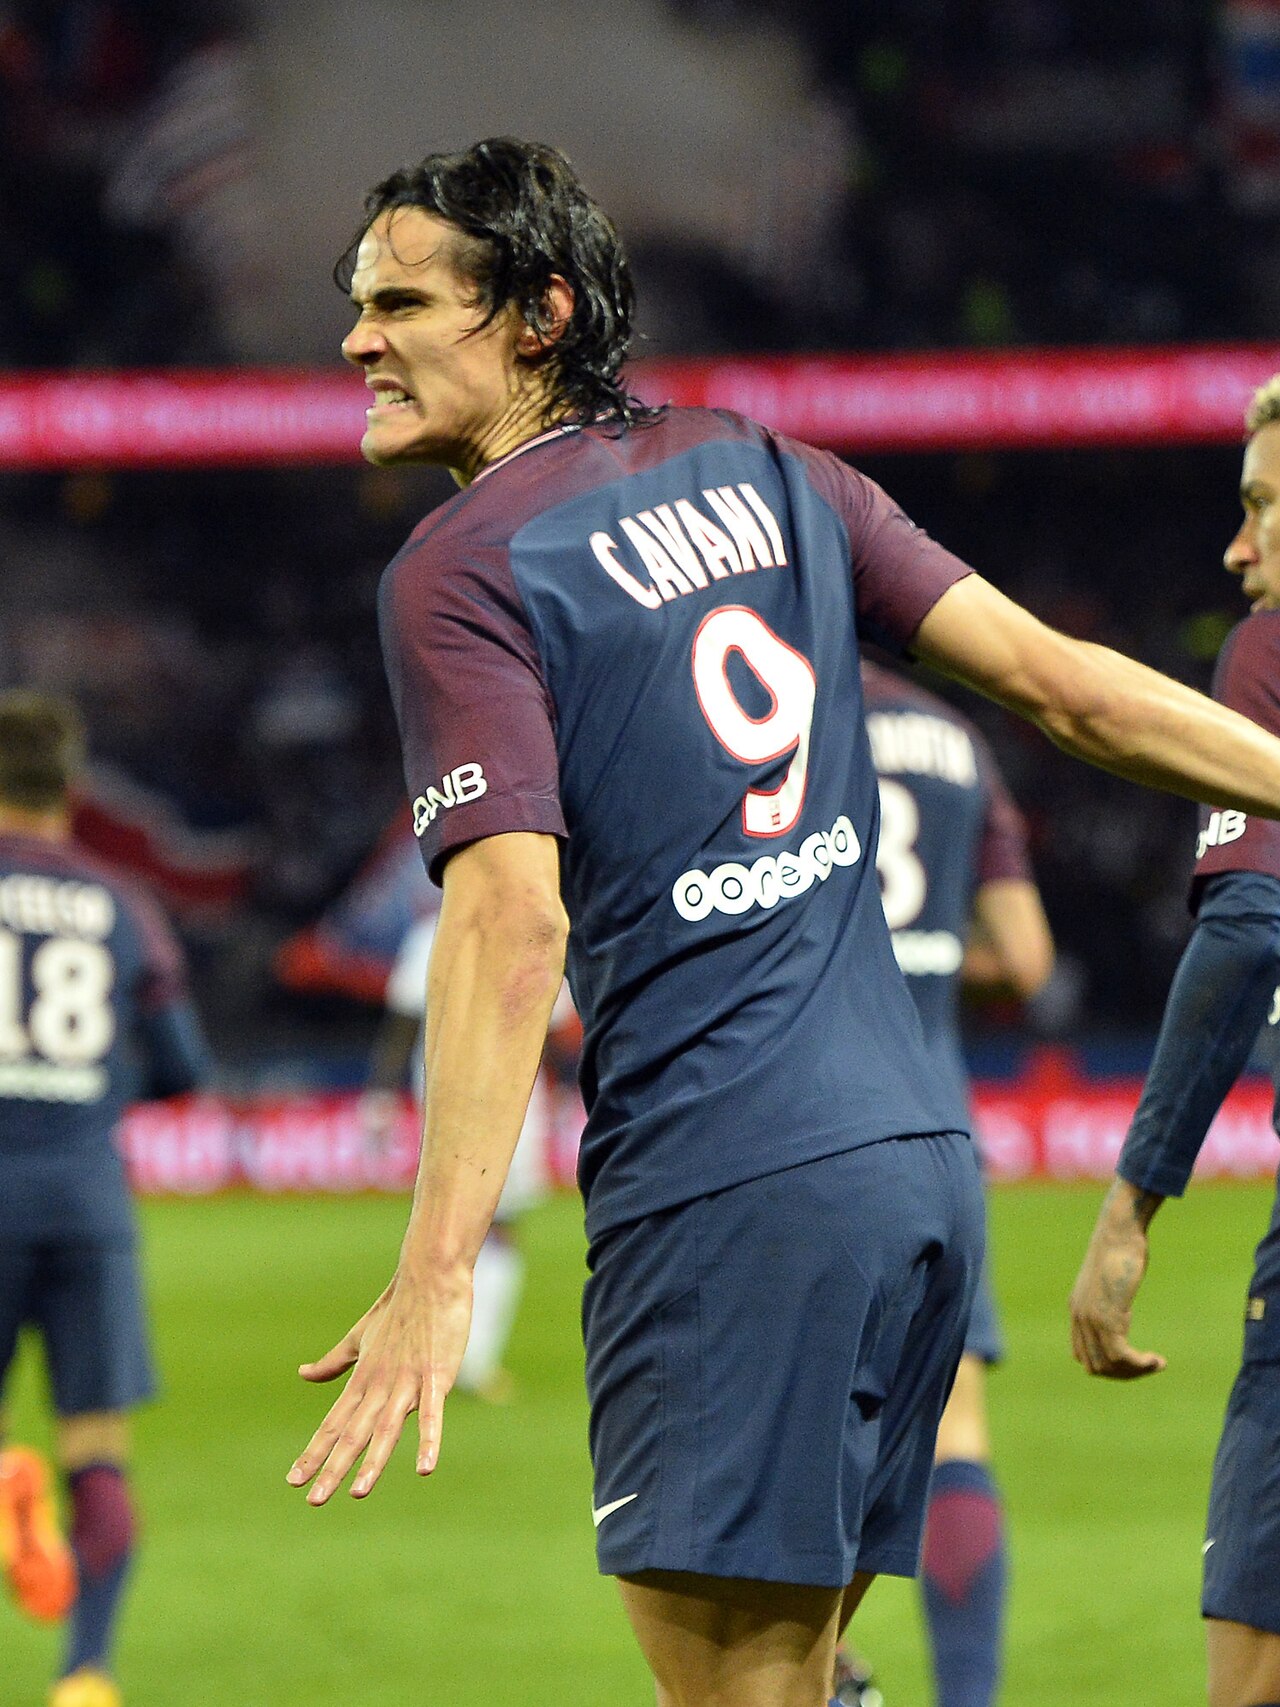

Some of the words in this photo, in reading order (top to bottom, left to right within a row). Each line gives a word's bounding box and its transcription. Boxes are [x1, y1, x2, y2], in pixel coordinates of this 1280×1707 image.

[588, 483, 787, 611] CAVANI
[692, 604, 817, 838] 9
[412, 763, 488, 837] QNB
